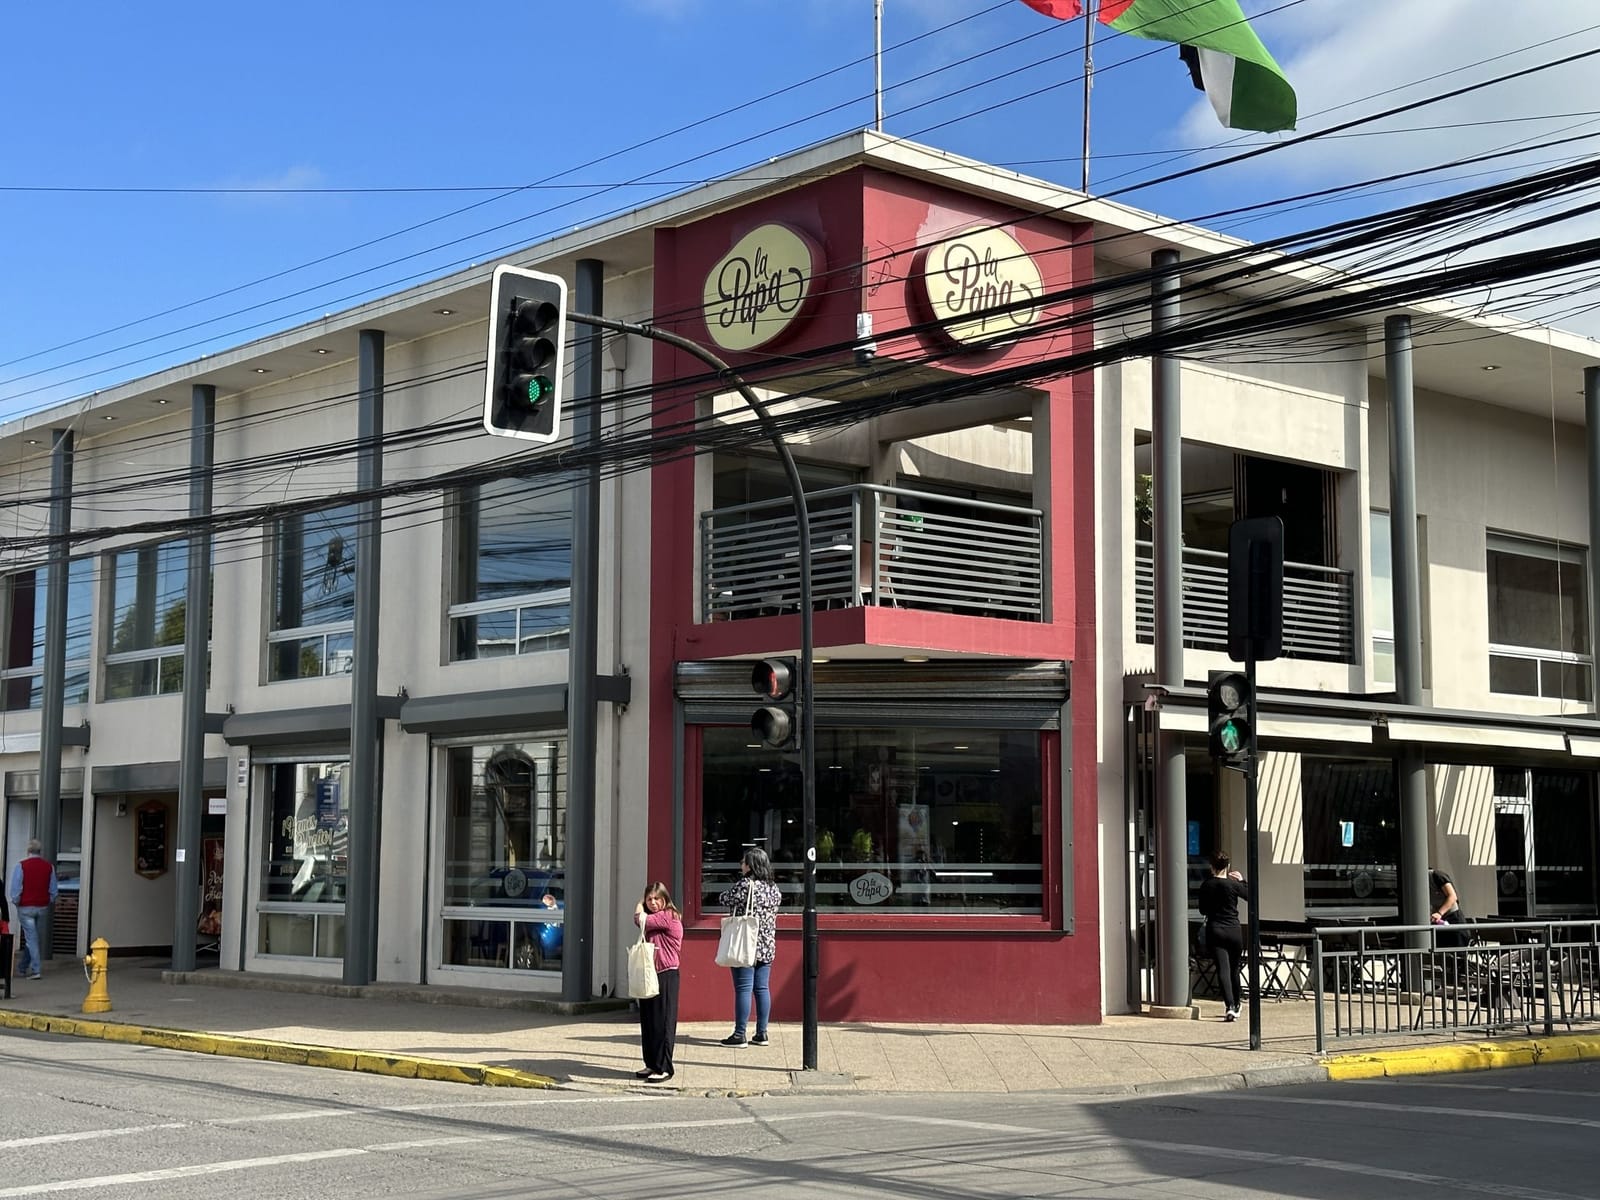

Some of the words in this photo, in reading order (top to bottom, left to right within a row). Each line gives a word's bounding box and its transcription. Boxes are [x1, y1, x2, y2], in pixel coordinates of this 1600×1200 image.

[754, 246, 769, 280] la
[984, 246, 999, 284] la
[718, 257, 804, 335] Papa
[944, 243, 1034, 332] Papa
[856, 878, 890, 901] Papa
